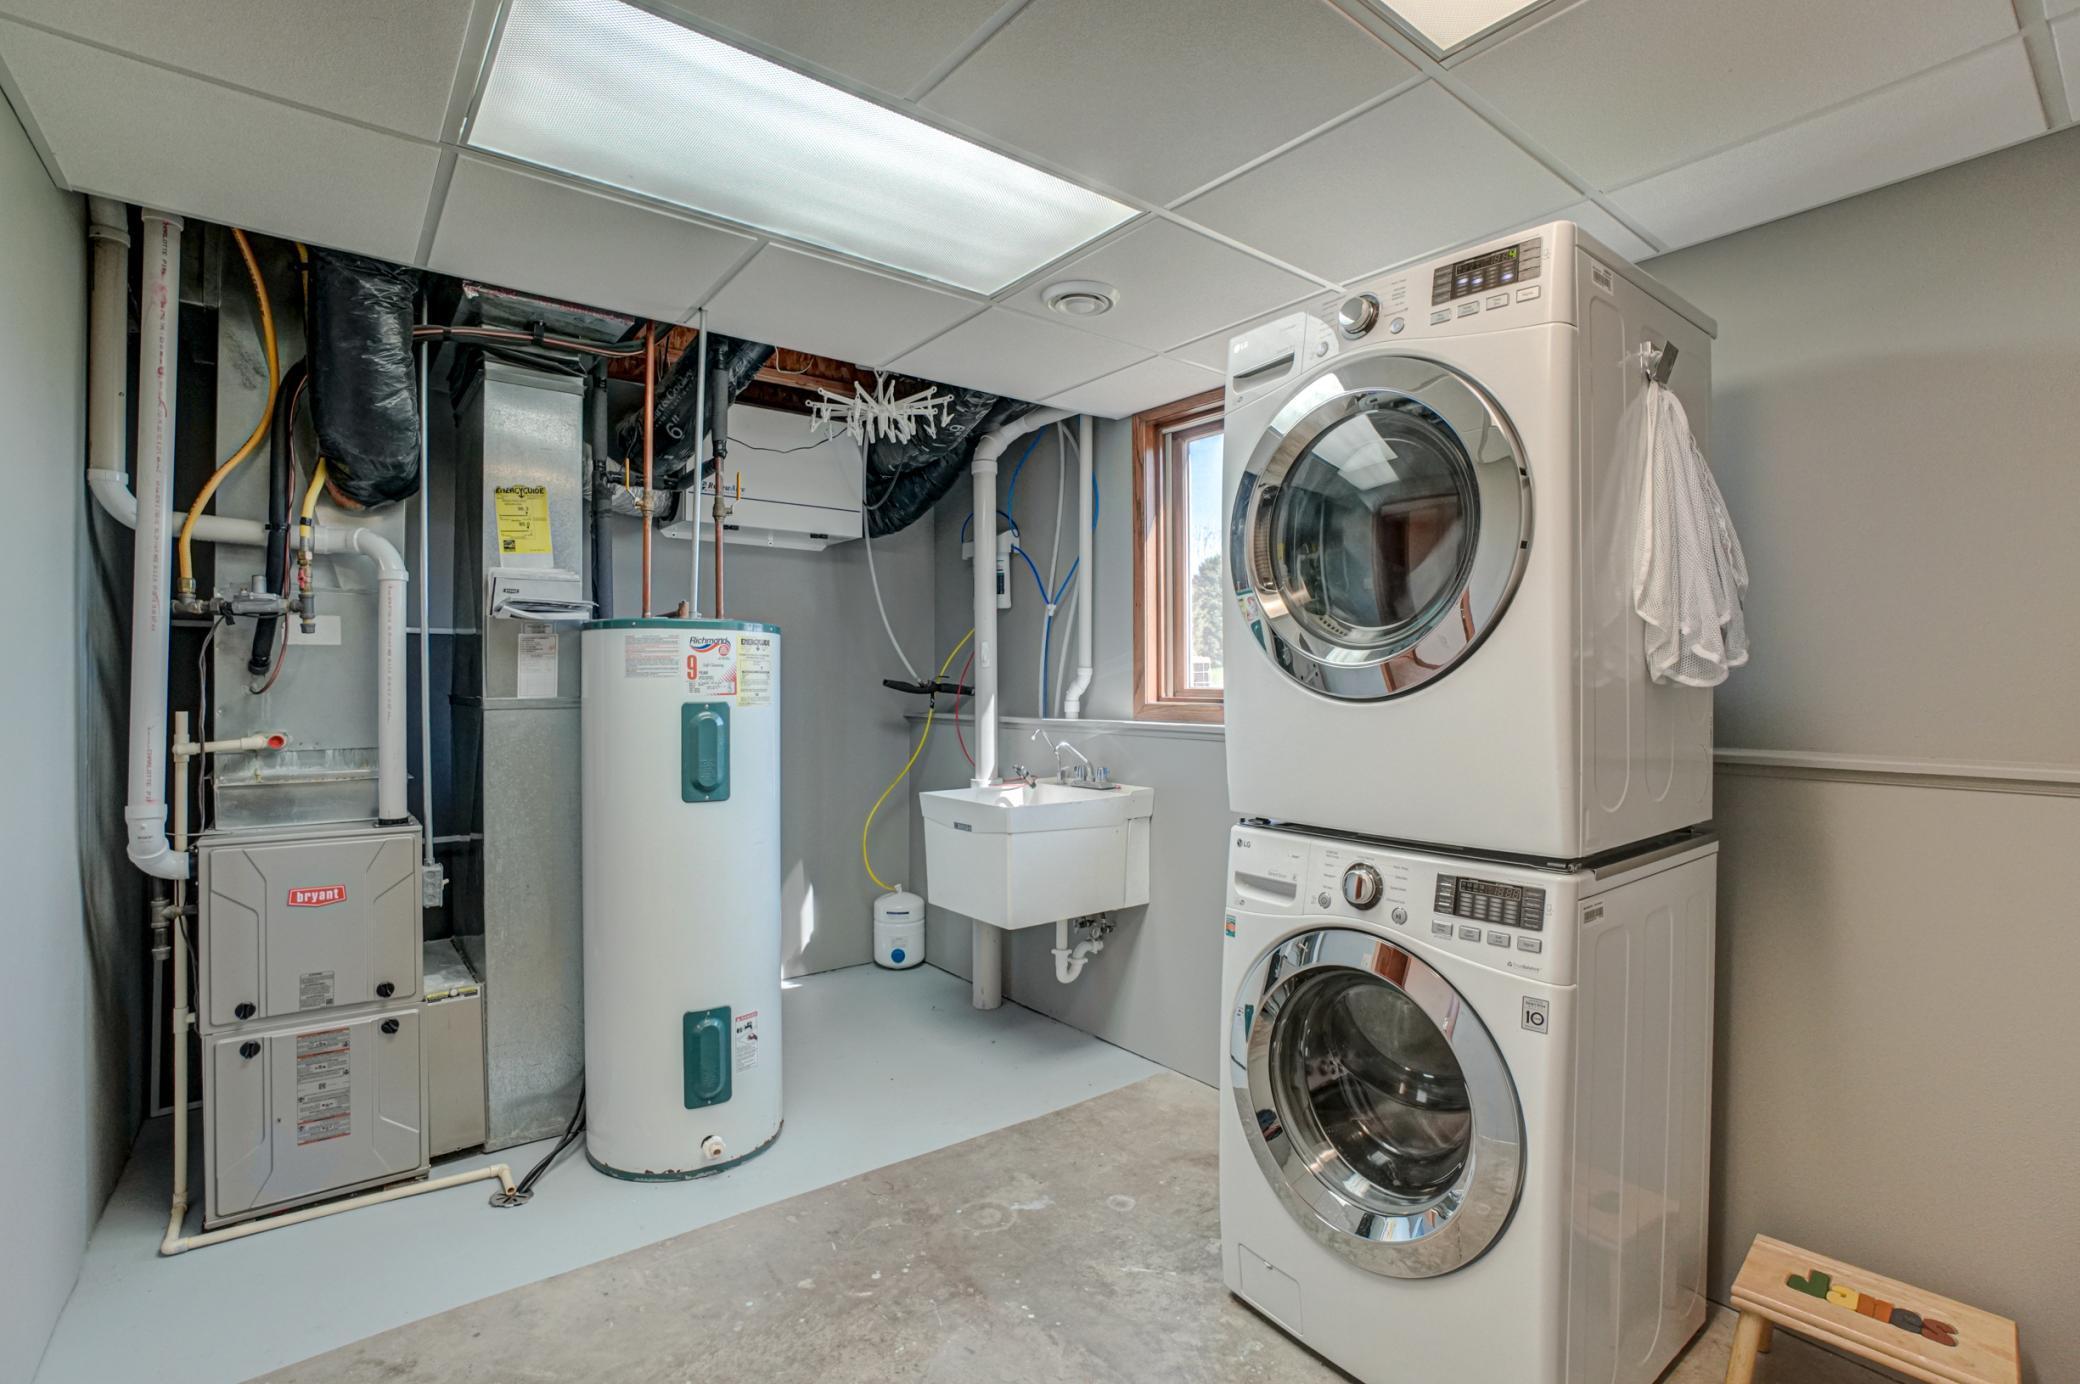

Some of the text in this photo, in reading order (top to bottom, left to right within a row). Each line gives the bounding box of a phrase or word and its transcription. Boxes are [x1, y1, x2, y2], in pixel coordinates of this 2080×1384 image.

[690, 636, 729, 646] Richmond
[687, 654, 698, 680] 9
[296, 888, 339, 903] bryant
[1526, 1010, 1544, 1026] 10
